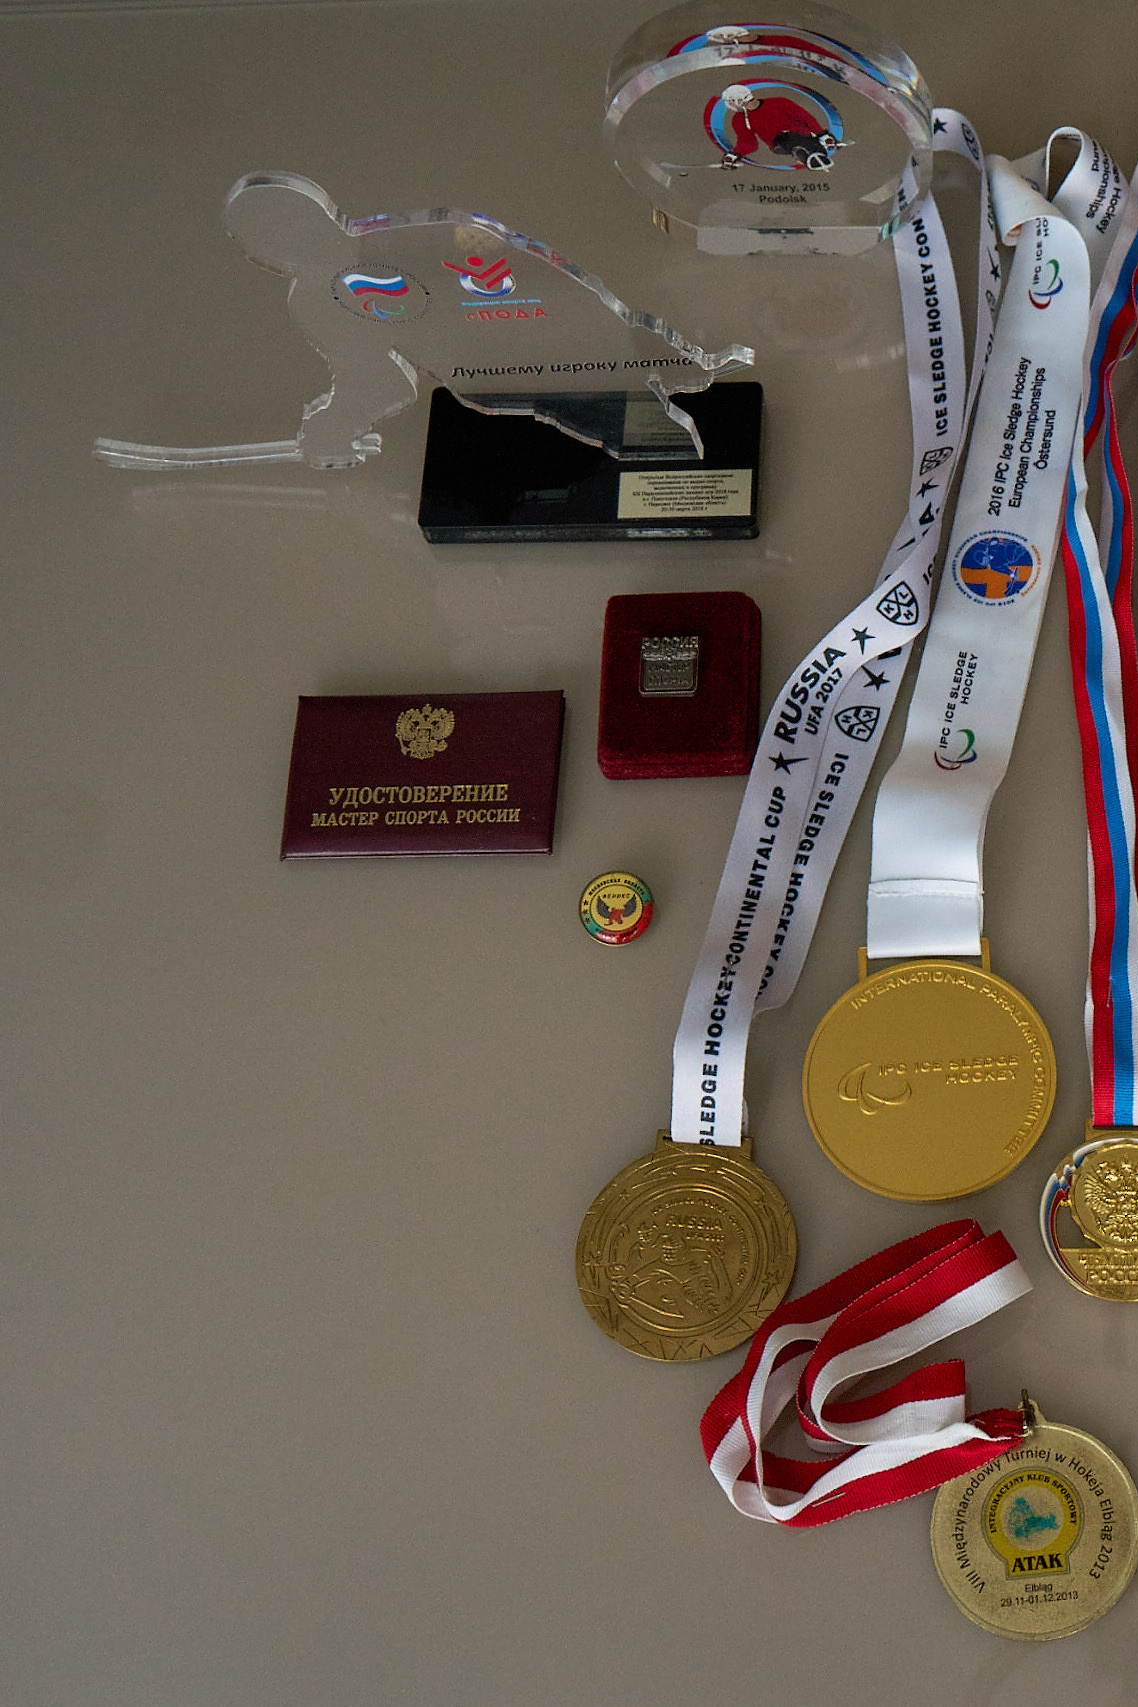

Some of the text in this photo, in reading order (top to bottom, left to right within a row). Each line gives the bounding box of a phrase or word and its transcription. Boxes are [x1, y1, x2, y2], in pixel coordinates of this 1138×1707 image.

[730, 183, 745, 193] 17
[802, 182, 831, 192] 2015
[759, 194, 808, 204] Podolsk
[919, 264, 942, 332] HOCKEY
[451, 356, 693, 378] Лучшему игроку матча
[929, 336, 948, 404] SLEDGE
[933, 407, 949, 437] ICE
[987, 356, 1032, 516] 2016 IPC Ice Sledge Hockey
[1008, 367, 1046, 508] European Championships
[1032, 410, 1056, 470] Östersund
[773, 646, 847, 745] RUSSIA
[804, 667, 844, 736] UFA 2017
[938, 650, 968, 750] IPC ICE SLEDGE
[960, 652, 979, 705] HOCKEY
[310, 807, 521, 828] МАСТЕР СПОРТА РОССИИ
[328, 783, 509, 809] УДОСТОВЕРЕНИЕ
[764, 786, 787, 829] CUP
[770, 752, 850, 961] ICE SLEDGE HOCKEY
[725, 833, 776, 966] CONTINENTAL
[703, 965, 738, 1057] HOCKEY
[850, 971, 977, 1010] INTERNATIONAL
[878, 1054, 1019, 1077] IPC ICE SLEDGE
[945, 1069, 1016, 1085] HOCKEY
[698, 1063, 719, 1146] SLEDGE
[952, 1448, 1116, 1594] VIII Międzynarodowy Turniej w Hokeja Elbląg 2013
[987, 1473, 1079, 1534] INTEGRACYJNY KLUB SPORTOWY
[1012, 1552, 1064, 1573] ATAK
